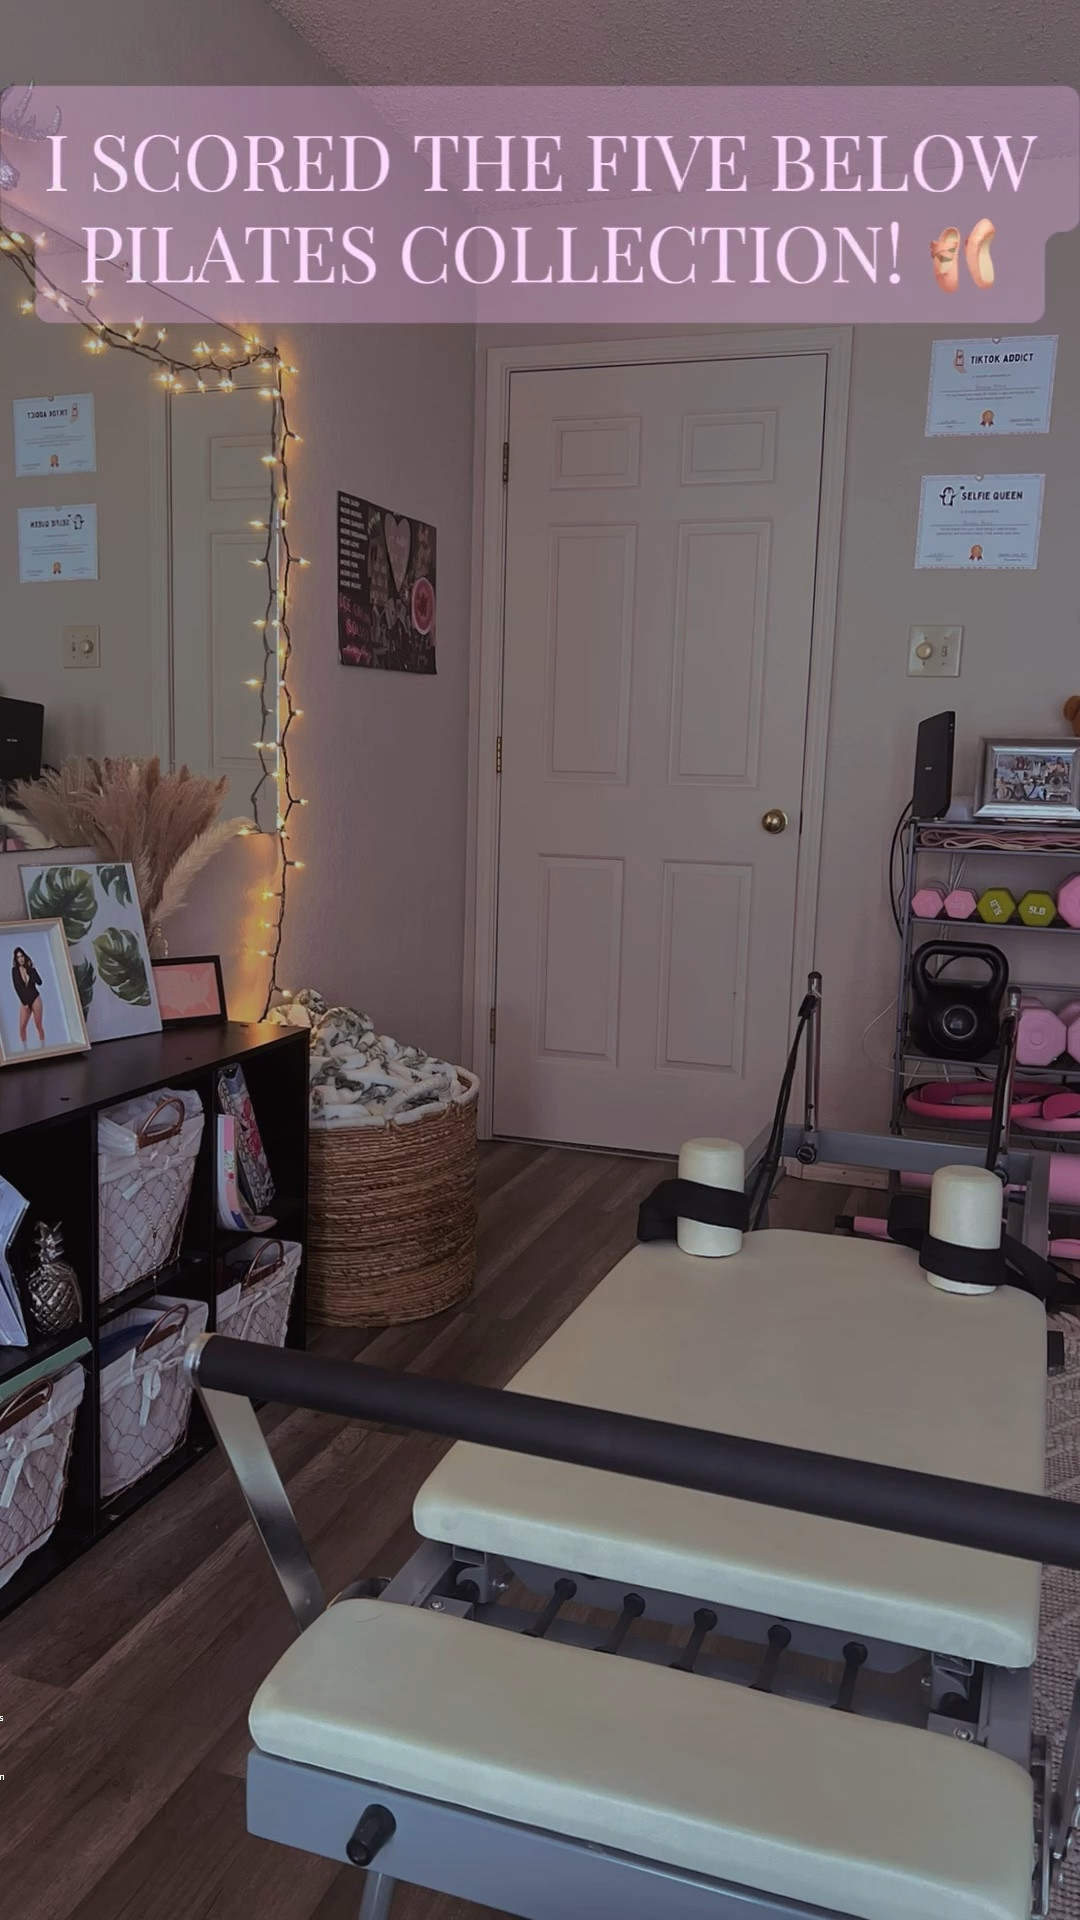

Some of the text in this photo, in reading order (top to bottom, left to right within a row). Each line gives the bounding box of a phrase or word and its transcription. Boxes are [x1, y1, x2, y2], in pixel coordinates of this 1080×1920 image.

[971, 353, 1034, 365] TIKTOK ADDICT
[962, 491, 1023, 500] SELFIE QUEEN
[1028, 905, 1046, 915] 5LB
